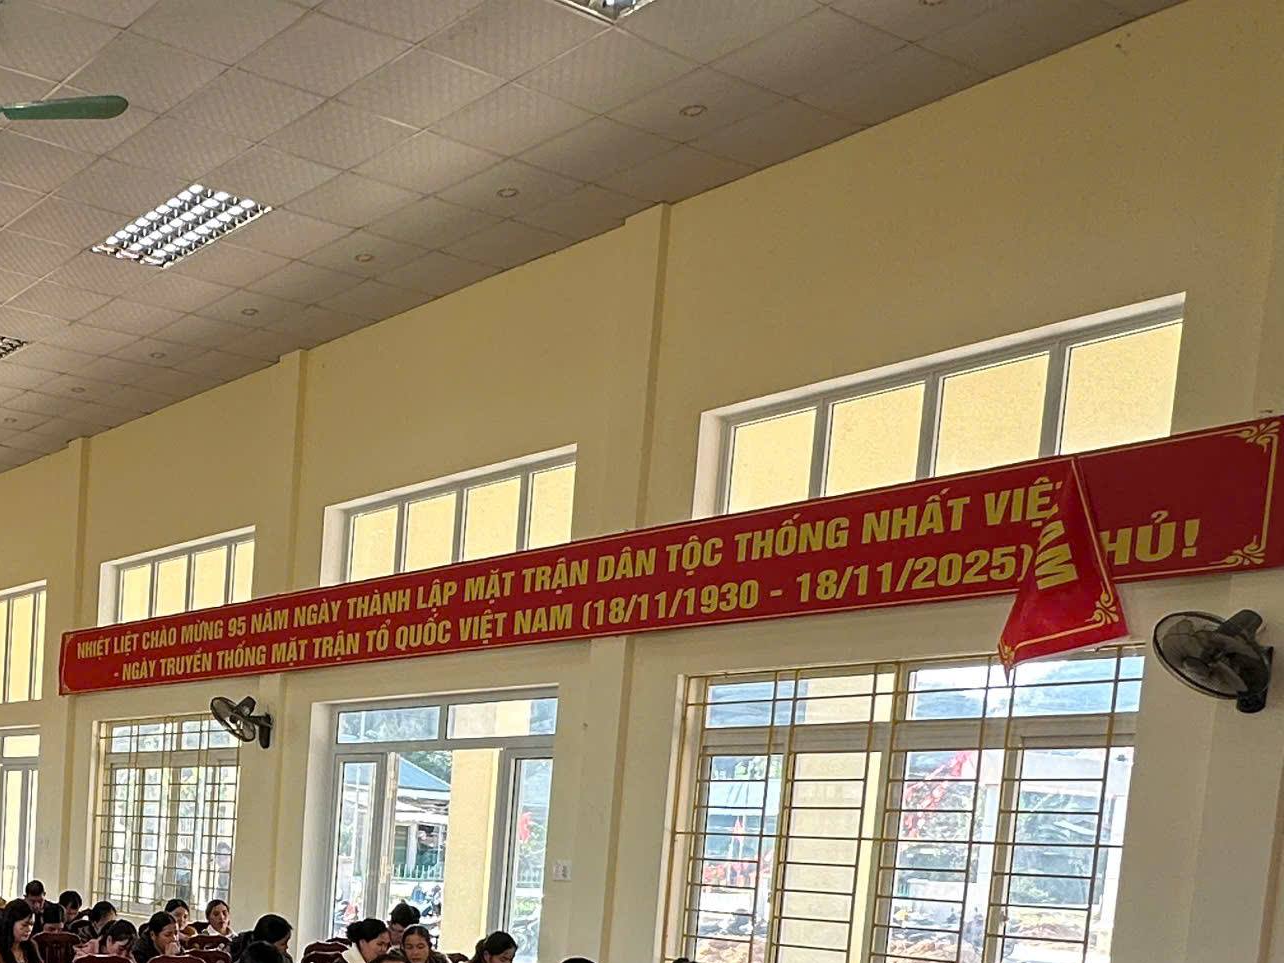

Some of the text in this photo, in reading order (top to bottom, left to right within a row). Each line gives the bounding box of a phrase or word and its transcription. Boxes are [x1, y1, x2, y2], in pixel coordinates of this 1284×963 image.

[77, 476, 1060, 662] NHIỆT LIỆT CHÀO MỪNG 95 NĂM NGÀY THÀNH LẬP MẶT TRẬN DÂN TỘC THỐNG NHẤT VIỆ
[1099, 510, 1201, 566] HỦ!
[122, 656, 157, 681] NGÀY
[160, 647, 213, 677] TRUYỀN
[217, 639, 266, 669] THỐNG
[271, 634, 308, 667] MẶT
[313, 630, 360, 661] TRẬN
[366, 618, 392, 652] TỔ
[395, 612, 452, 652] QUỐC
[459, 609, 508, 645] VIỆT
[513, 603, 573, 636] NAM
[582, 579, 760, 630] (18/11/1930
[769, 589, 783, 598] -
[796, 544, 1034, 603] 18/11/2025)
